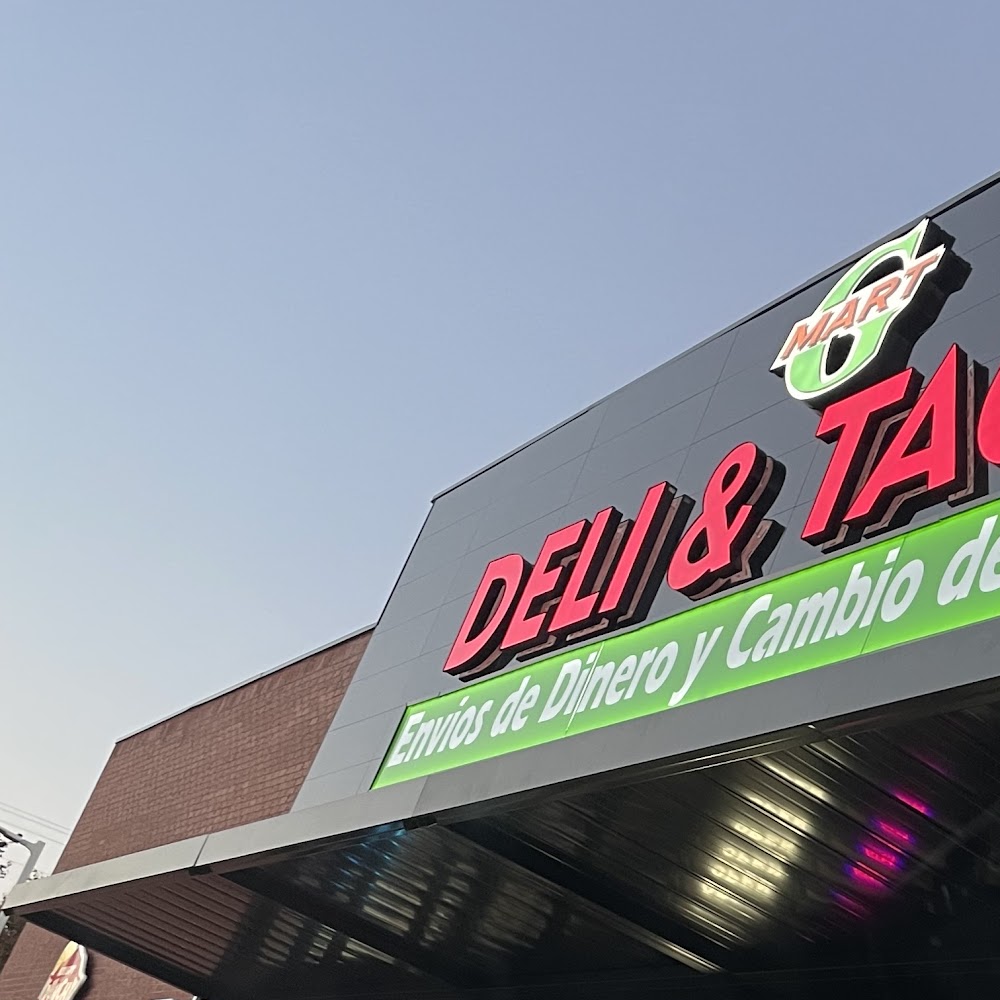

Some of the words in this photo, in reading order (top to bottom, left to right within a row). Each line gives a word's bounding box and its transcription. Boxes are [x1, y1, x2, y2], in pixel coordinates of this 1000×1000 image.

[780, 253, 940, 360] MART
[442, 481, 670, 673] DELI
[666, 441, 758, 592] &
[490, 675, 541, 738] de
[537, 641, 680, 723] Dinero
[666, 625, 724, 708] y
[725, 547, 926, 669] Cambio
